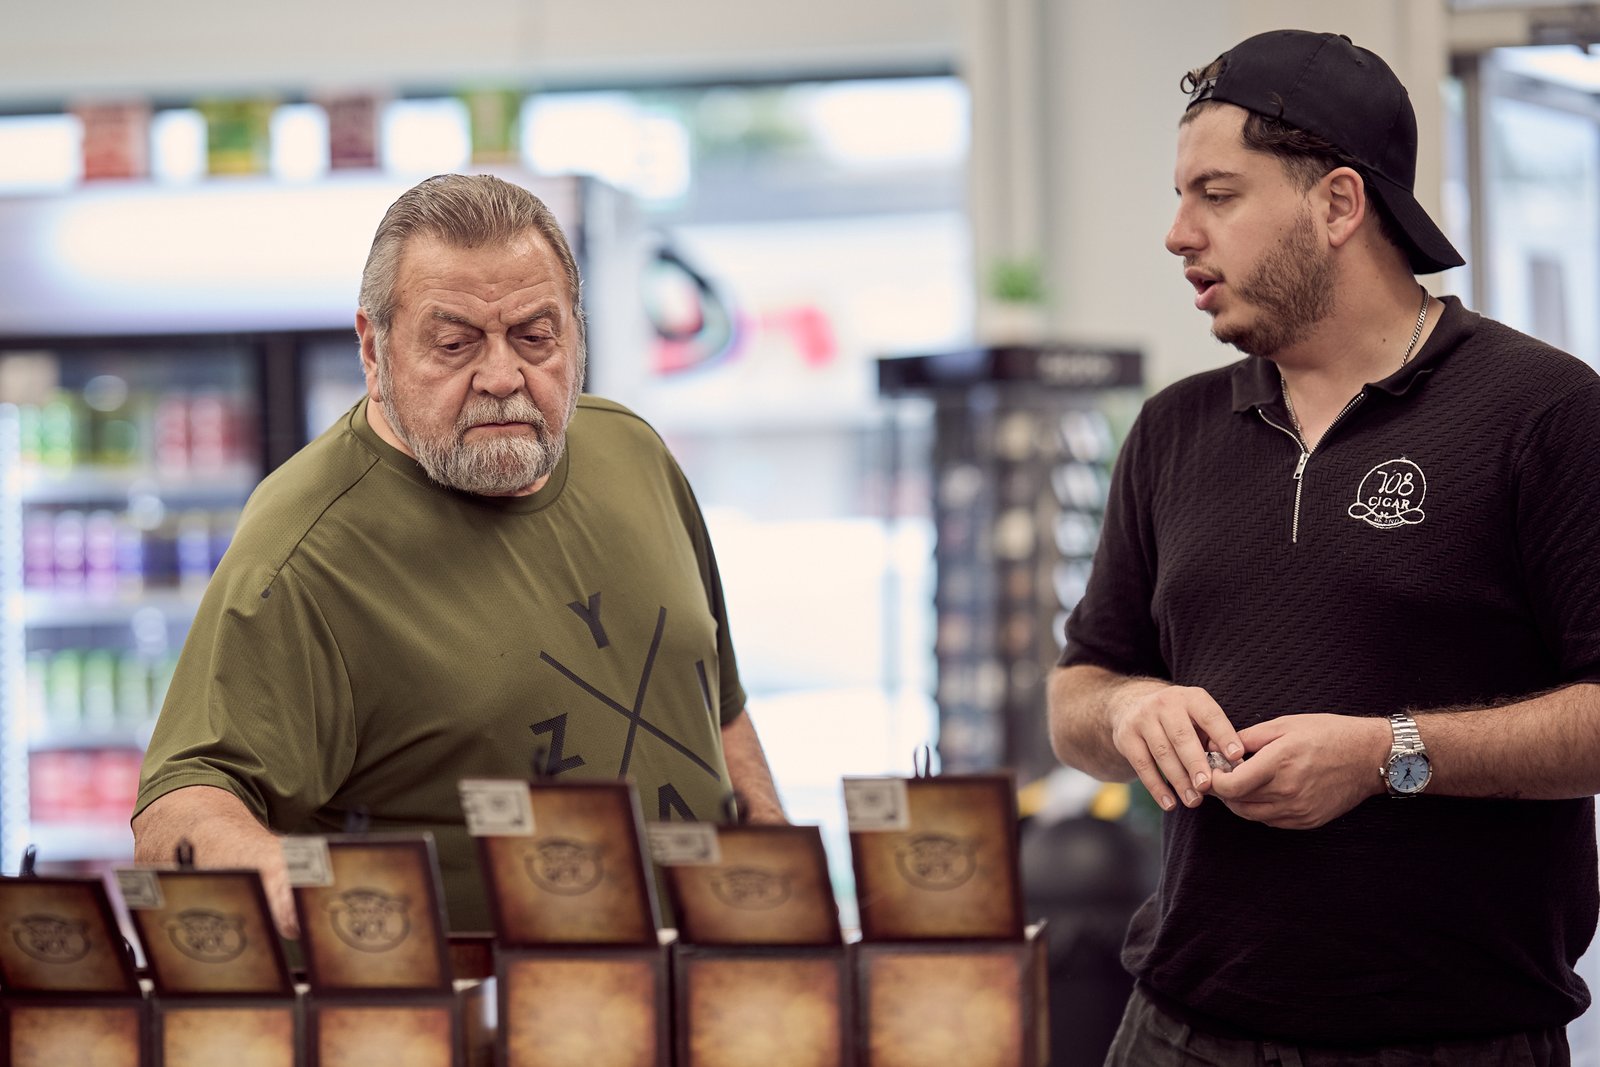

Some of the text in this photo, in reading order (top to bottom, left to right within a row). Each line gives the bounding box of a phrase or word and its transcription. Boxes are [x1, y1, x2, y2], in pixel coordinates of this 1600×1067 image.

[1368, 496, 1410, 510] CIGAR
[1377, 470, 1415, 496] 708
[567, 591, 610, 649] Y
[529, 712, 586, 777] Z
